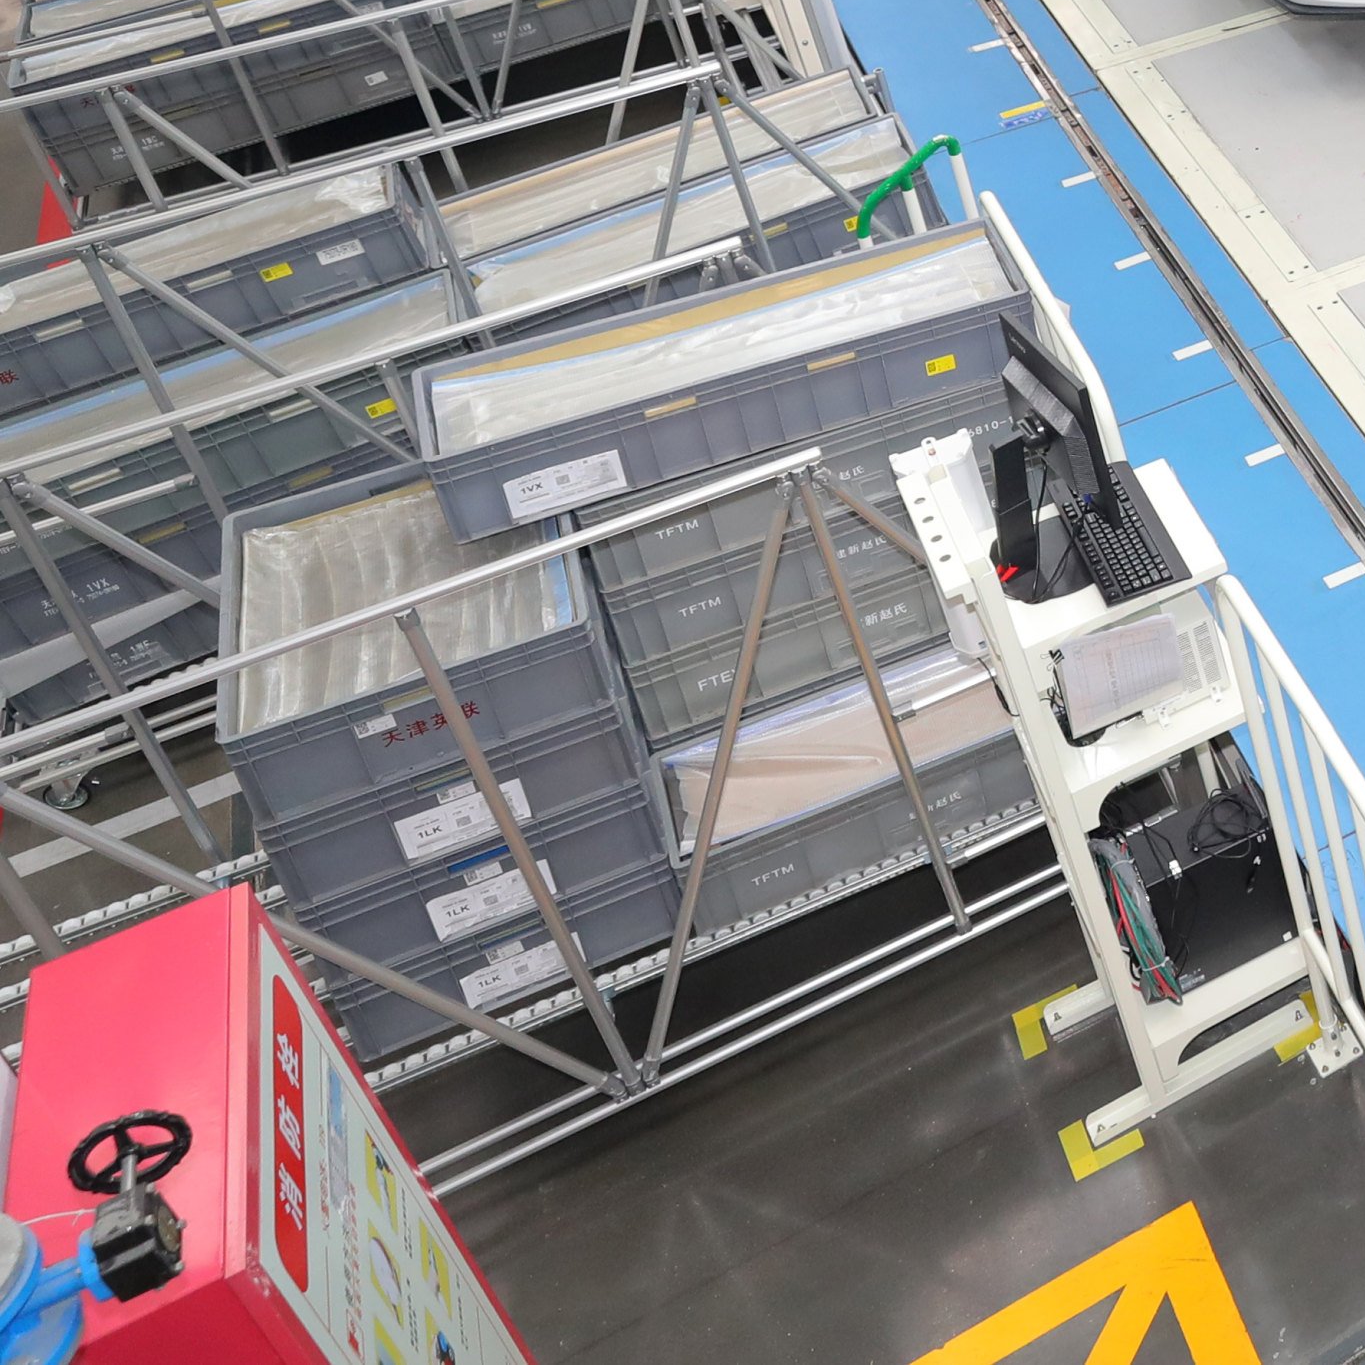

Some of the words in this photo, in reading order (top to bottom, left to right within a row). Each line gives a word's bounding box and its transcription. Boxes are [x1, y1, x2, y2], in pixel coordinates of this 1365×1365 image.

[520, 482, 543, 494] 1VX
[655, 518, 699, 540] TFTM
[86, 578, 110, 592] 1VX
[679, 596, 722, 618] TFTM
[861, 603, 908, 628] 新赵氏
[382, 700, 481, 748] 天津英联
[418, 824, 443, 839] 1LK
[751, 863, 795, 887] TFTM
[445, 904, 471, 918] 1LK
[477, 974, 502, 988] 1LK
[277, 1033, 303, 1231] 消防栓
